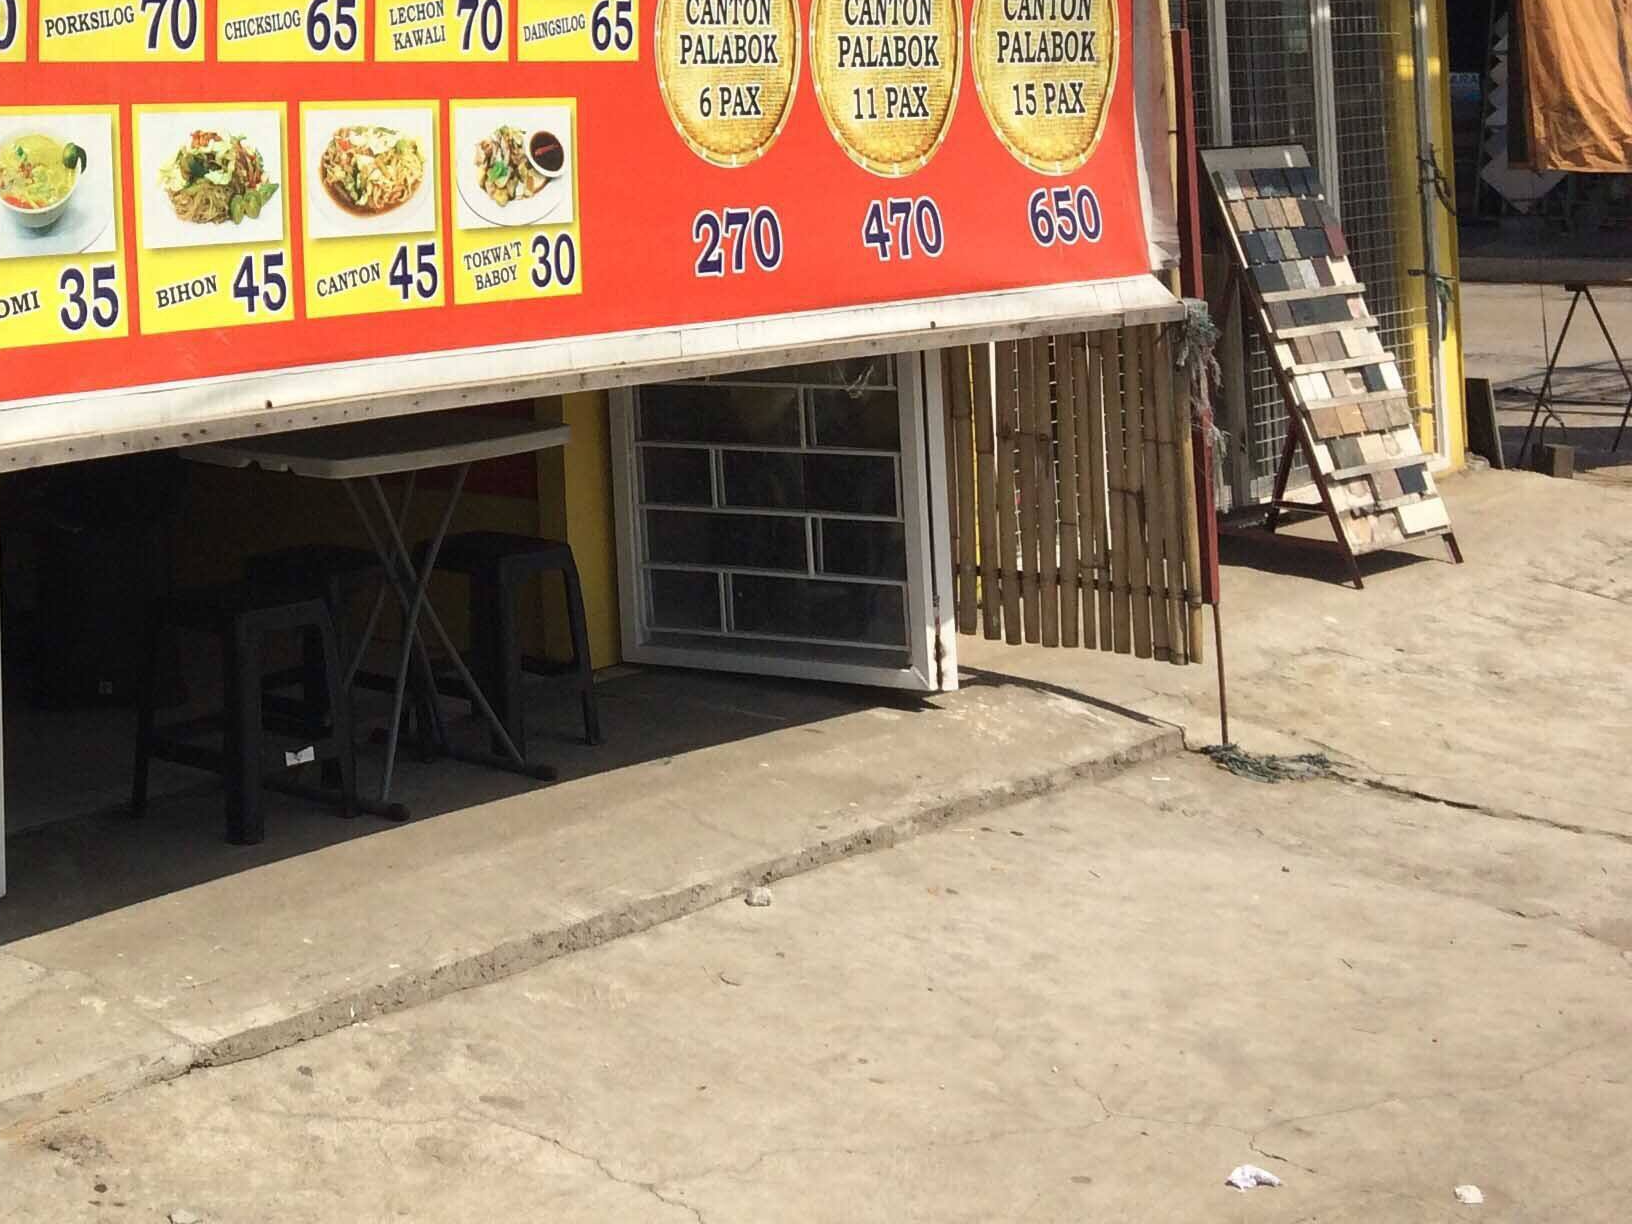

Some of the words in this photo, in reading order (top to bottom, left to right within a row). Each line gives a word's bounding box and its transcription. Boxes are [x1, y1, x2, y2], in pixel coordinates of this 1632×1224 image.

[44, 5, 135, 38] PORKSILOG
[224, 9, 301, 42] CHICKSILOG
[388, 0, 445, 26] LECHON
[522, 14, 586, 42] DAINGSILOG
[591, 0, 634, 51] 65
[393, 25, 447, 52] KAWALI
[679, 32, 778, 66] PALABOK
[837, 35, 939, 69] PALABOK
[996, 31, 1095, 63] PALABOK
[699, 88, 712, 117] 6
[719, 87, 762, 117] PAX
[853, 88, 876, 119] 11
[885, 86, 930, 118] PAX
[1012, 84, 1038, 116] 15
[1043, 82, 1086, 115] PAX
[865, 198, 943, 259] 470
[1030, 187, 1101, 246] 650
[463, 241, 522, 270] TOKWA'T
[694, 209, 782, 274] 270
[389, 242, 439, 300] 45
[531, 233, 576, 288] 30
[156, 275, 218, 308] BIHON
[233, 252, 287, 313] 45
[317, 263, 381, 297] CANTON
[474, 265, 518, 291] BABOY
[60, 264, 119, 331] 35
